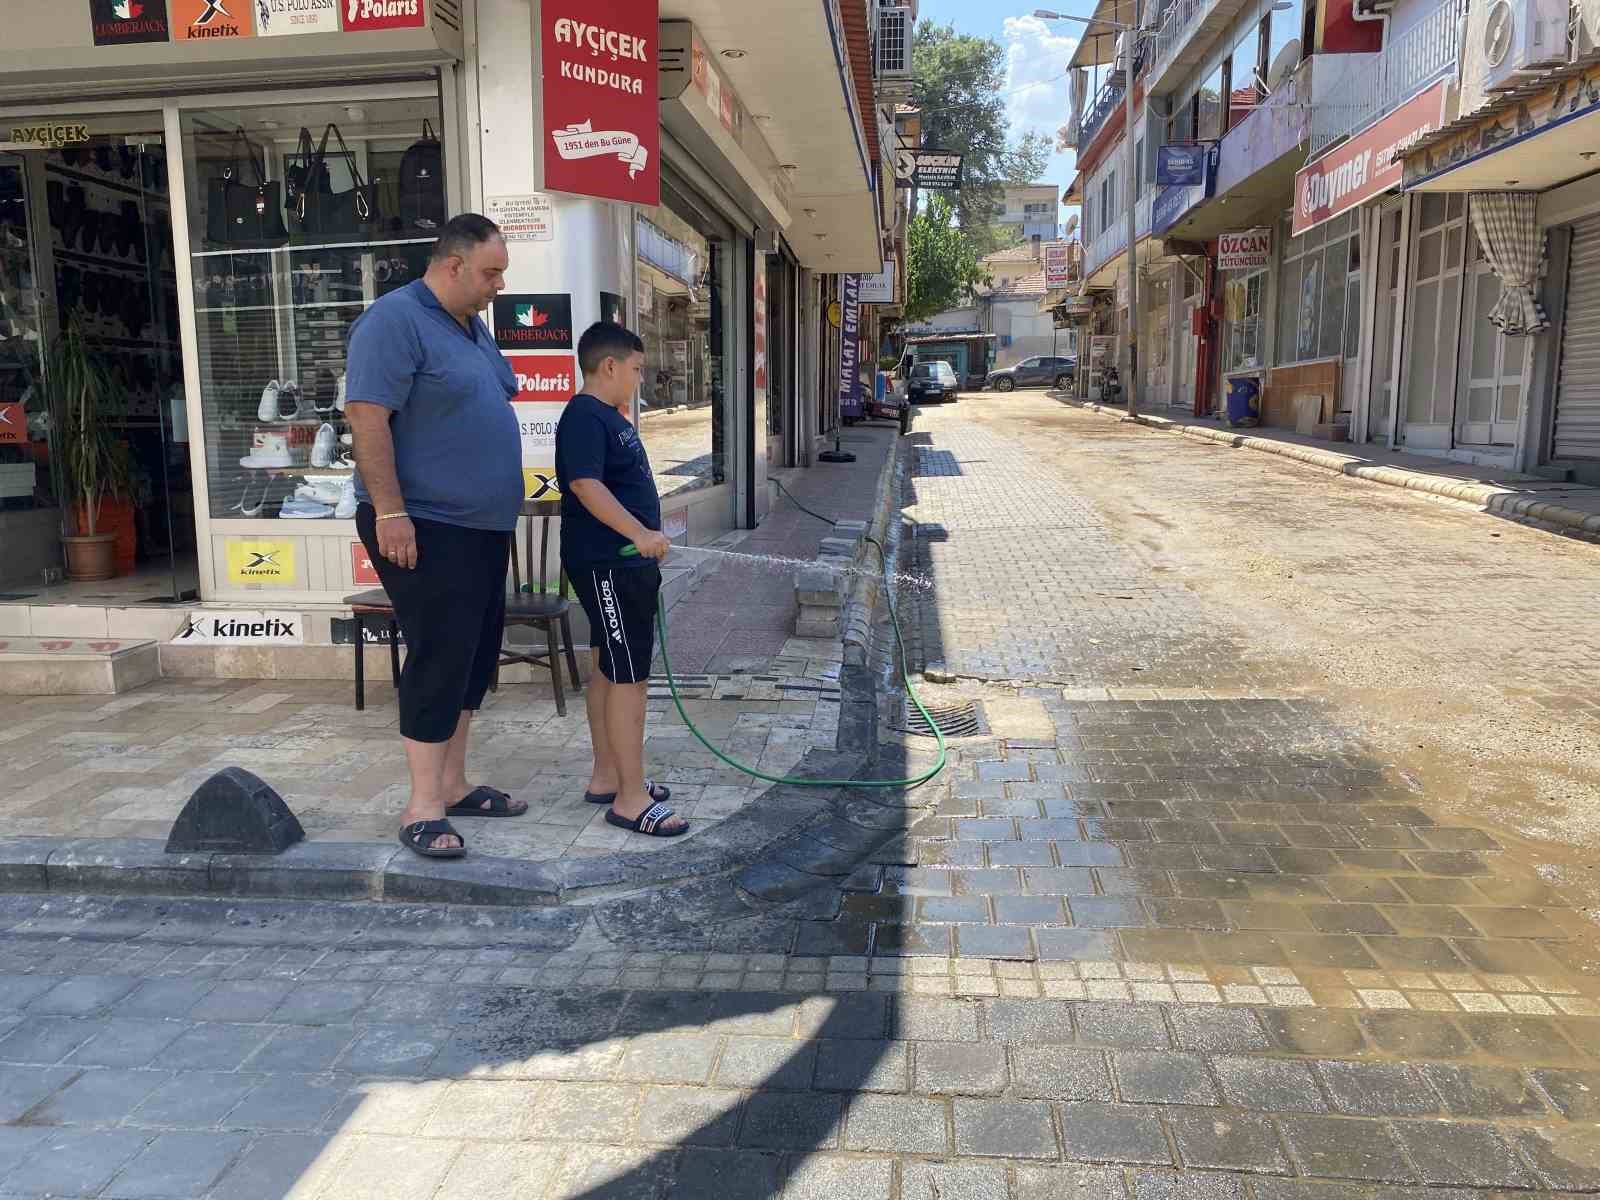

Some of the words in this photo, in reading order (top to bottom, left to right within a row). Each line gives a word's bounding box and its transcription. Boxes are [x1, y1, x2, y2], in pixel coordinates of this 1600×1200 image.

[360, 0, 418, 18] Polaris
[95, 20, 165, 35] LUMBERJACK
[187, 24, 239, 39] kinetix
[555, 17, 647, 62] AYÇİÇEK
[560, 60, 642, 94] KUNDURA
[12, 123, 89, 147] AYÇİÇEK
[564, 141, 583, 151] 1951
[584, 139, 599, 149] den
[601, 138, 611, 147] Bu
[612, 136, 632, 146] Güne
[1309, 148, 1371, 212] Duymer
[1220, 235, 1268, 254] ÖZCAN
[1220, 256, 1267, 266] TÜTÜNCÜLÜK
[845, 274, 858, 333] EMLAK
[498, 329, 568, 341] LUMBERJACK
[515, 372, 570, 392] Polaris
[530, 422, 552, 435] POLO
[240, 567, 280, 576] kinetix
[601, 580, 618, 629] adidas
[213, 618, 295, 637] kinetix
